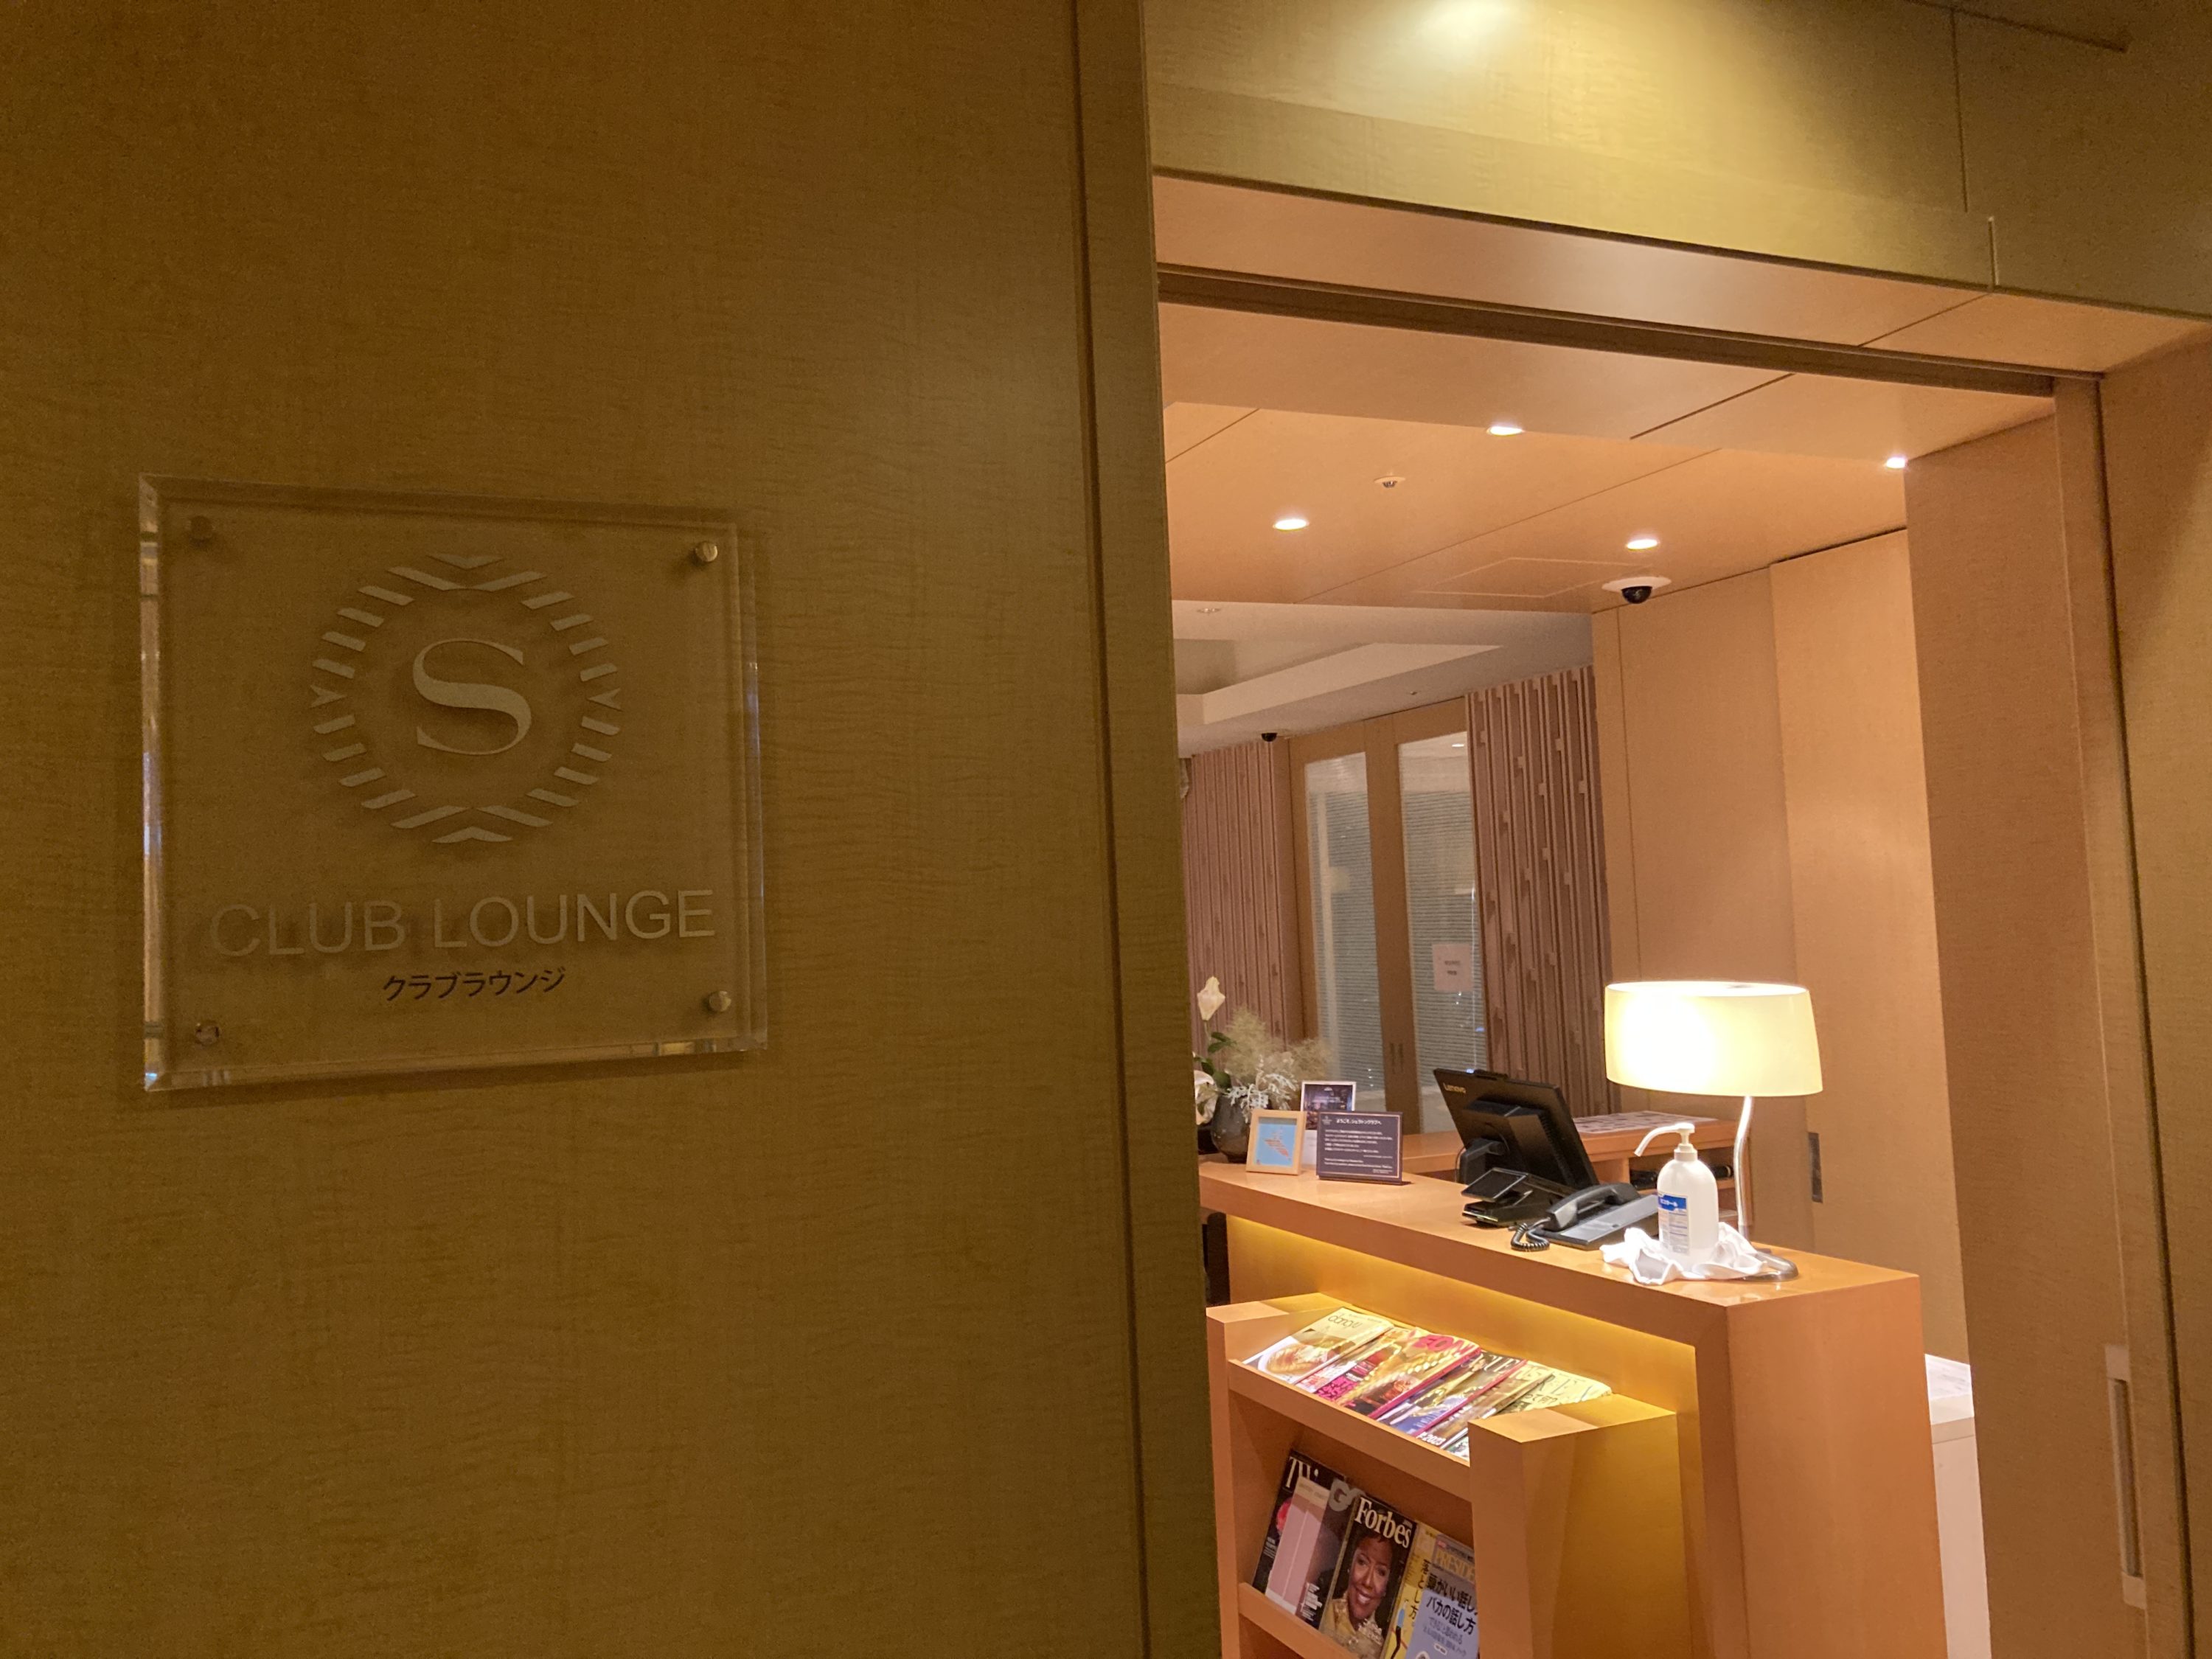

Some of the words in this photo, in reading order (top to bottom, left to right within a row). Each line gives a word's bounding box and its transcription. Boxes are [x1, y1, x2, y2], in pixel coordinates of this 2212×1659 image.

[412, 638, 532, 756] S
[209, 899, 407, 957] CLUB
[434, 889, 715, 948] LOUNGE
[383, 967, 566, 1001] クラブラウンジ
[1411, 1333, 1477, 1355] EON
[1354, 1497, 1411, 1548] Forbes
[1427, 1573, 1478, 1615] 頭がいい話し
